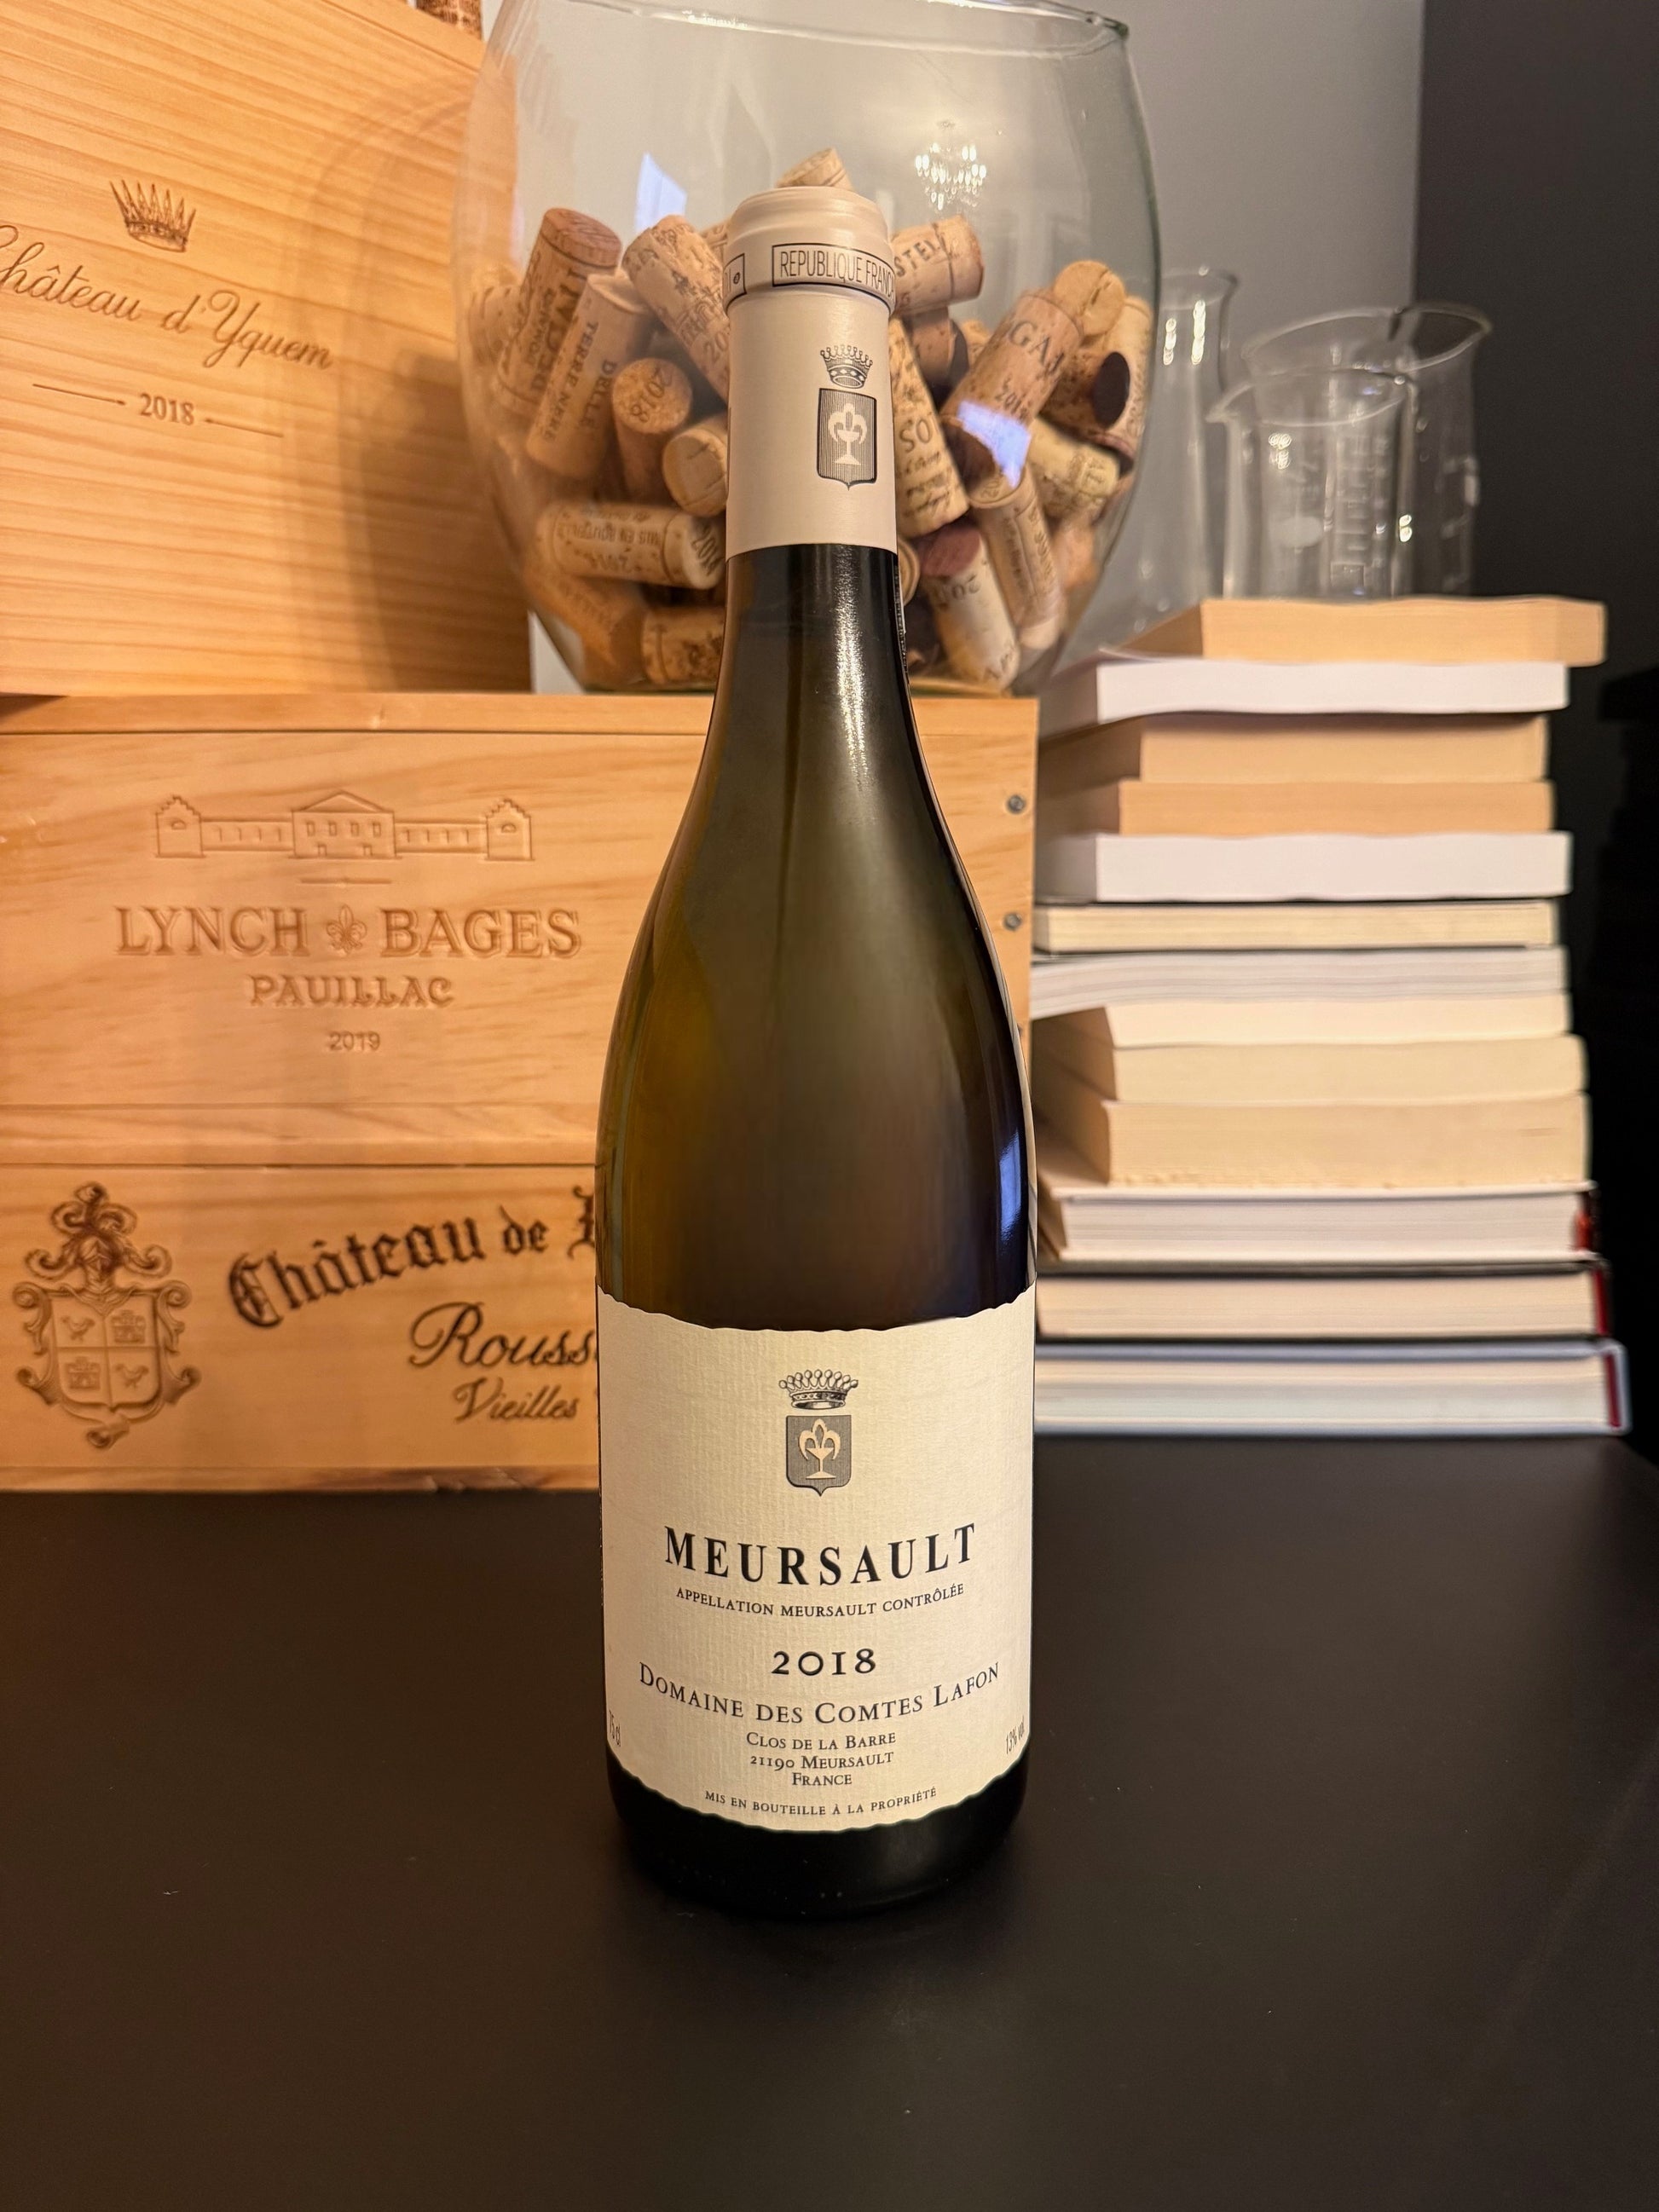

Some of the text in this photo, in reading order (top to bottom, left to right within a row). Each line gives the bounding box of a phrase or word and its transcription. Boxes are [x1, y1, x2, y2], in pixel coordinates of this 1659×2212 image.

[780, 250, 862, 284] REPUBLIQUE
[160, 289, 333, 369] d'Yquem
[139, 392, 195, 427] 2018
[114, 904, 582, 959] LYNCH BAGES
[249, 974, 454, 1009] PAUILLAC
[327, 1031, 381, 1053] 2019
[225, 1214, 487, 1329] Château
[499, 1204, 550, 1256] de
[409, 1302, 596, 1369] Rouss
[453, 1376, 578, 1423] Vieilles
[664, 1522, 975, 1586] MEURSAULT
[676, 1583, 964, 1618] APPELLATION MEURSAULT CONTRÔLÉE
[771, 1648, 876, 1677] 2018
[639, 1661, 1000, 1724] DOMAINE DES COMTES LAFON
[746, 1731, 897, 1750] CLOS DE LA BARRE
[750, 1751, 894, 1770] 21190 MEURSAULT
[792, 1772, 853, 1786] FRANCE
[705, 1786, 937, 1816] MIS EN BOUTEILLE À LA PROPRIÉTÉ
